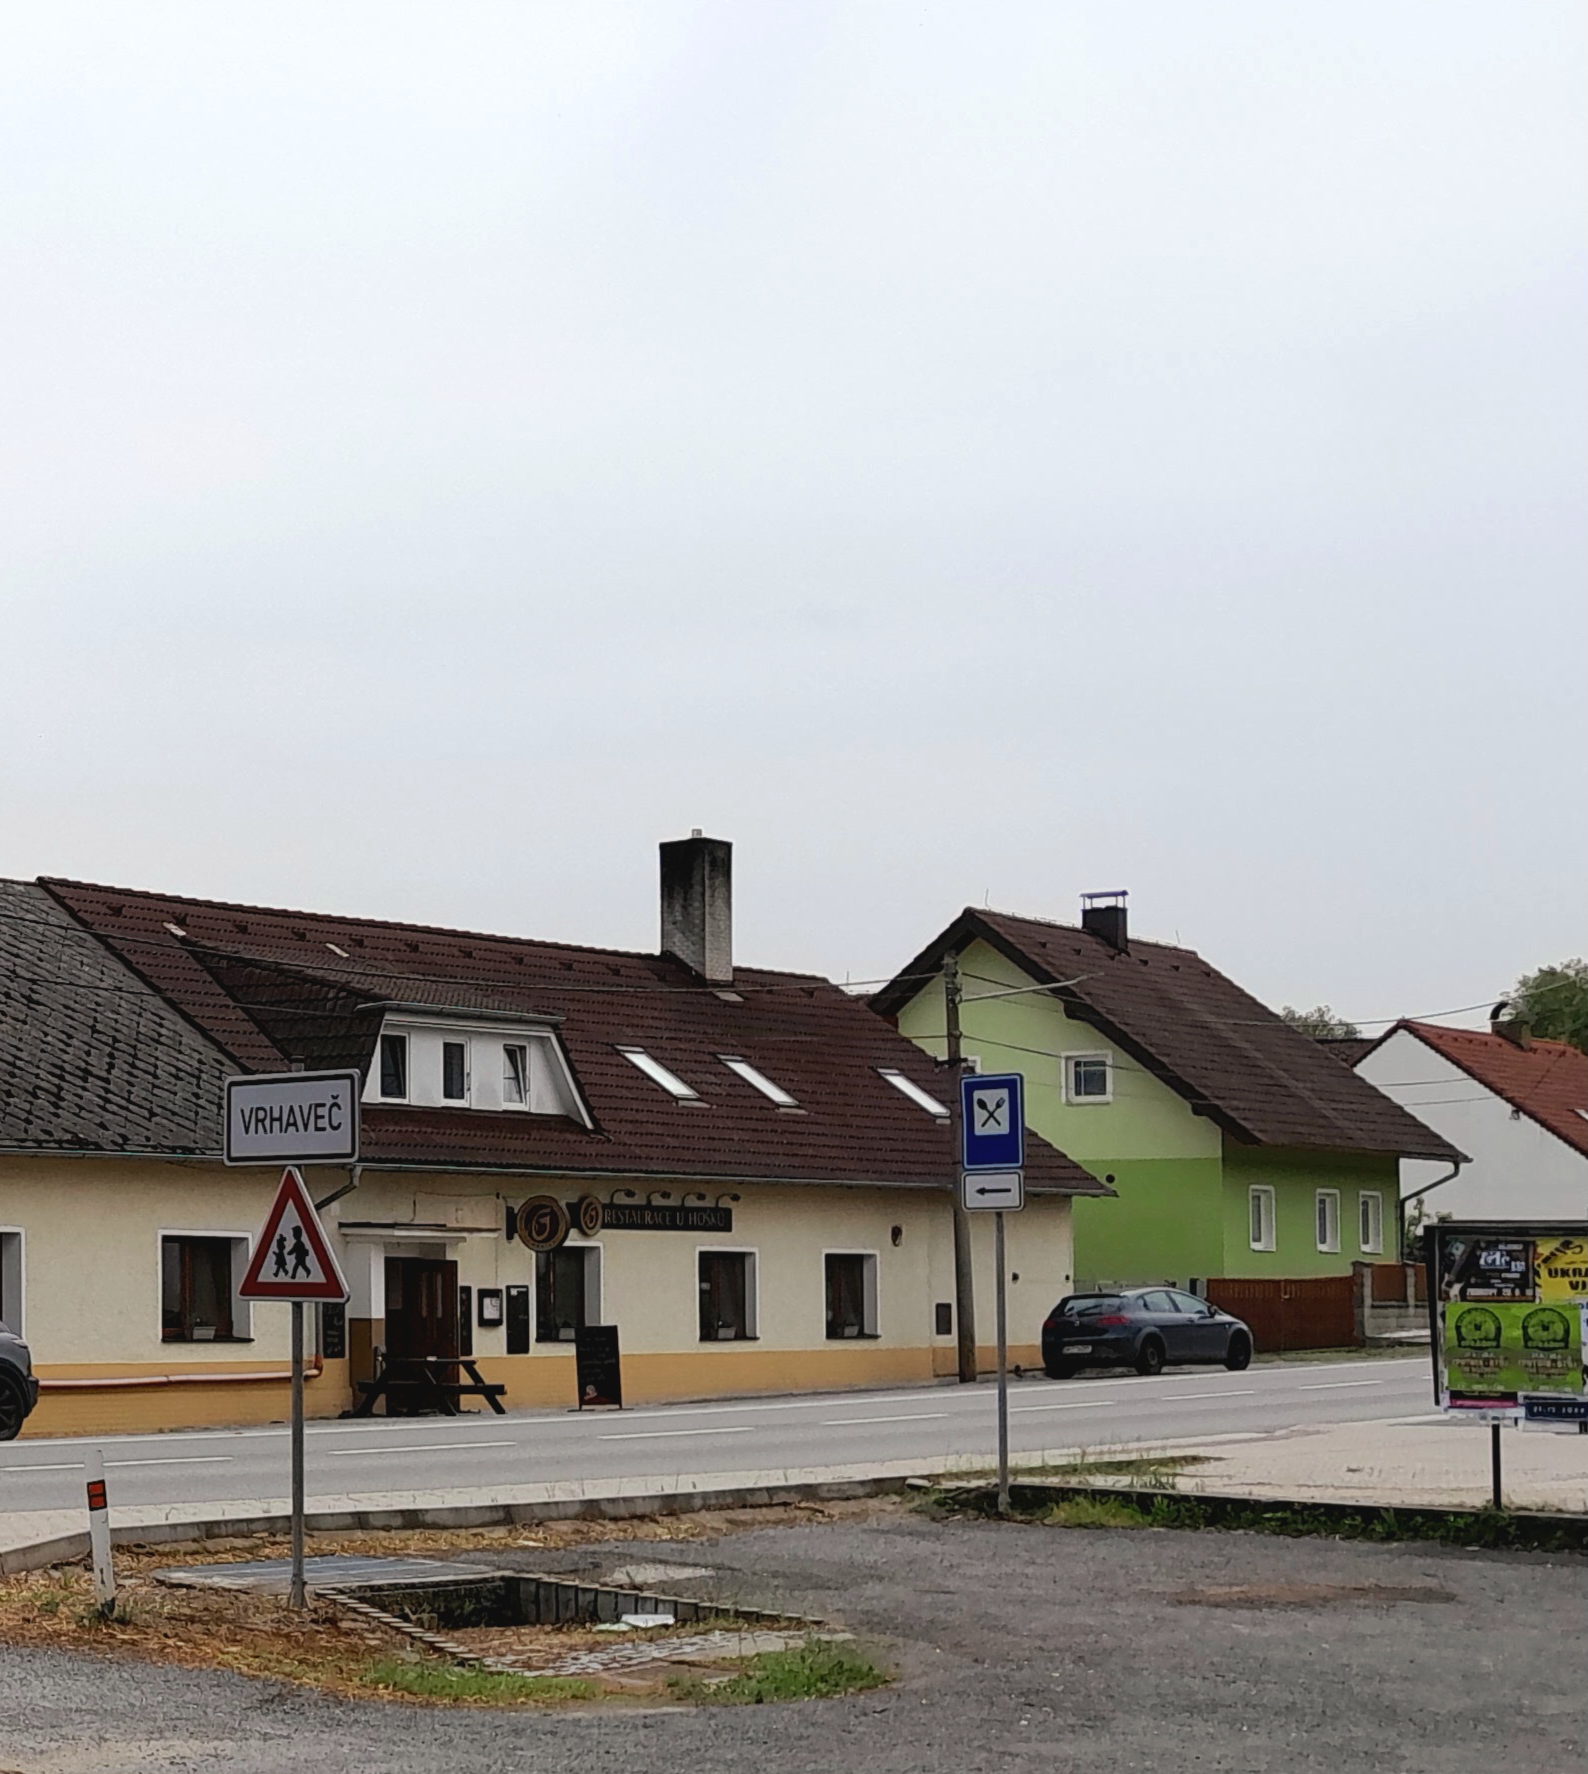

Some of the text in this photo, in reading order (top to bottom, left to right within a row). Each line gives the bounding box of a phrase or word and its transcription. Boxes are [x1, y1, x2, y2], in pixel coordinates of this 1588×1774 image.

[240, 1094, 342, 1135] VRHAVEČ
[604, 1208, 671, 1225] RESTAURACE
[676, 1211, 685, 1226] U
